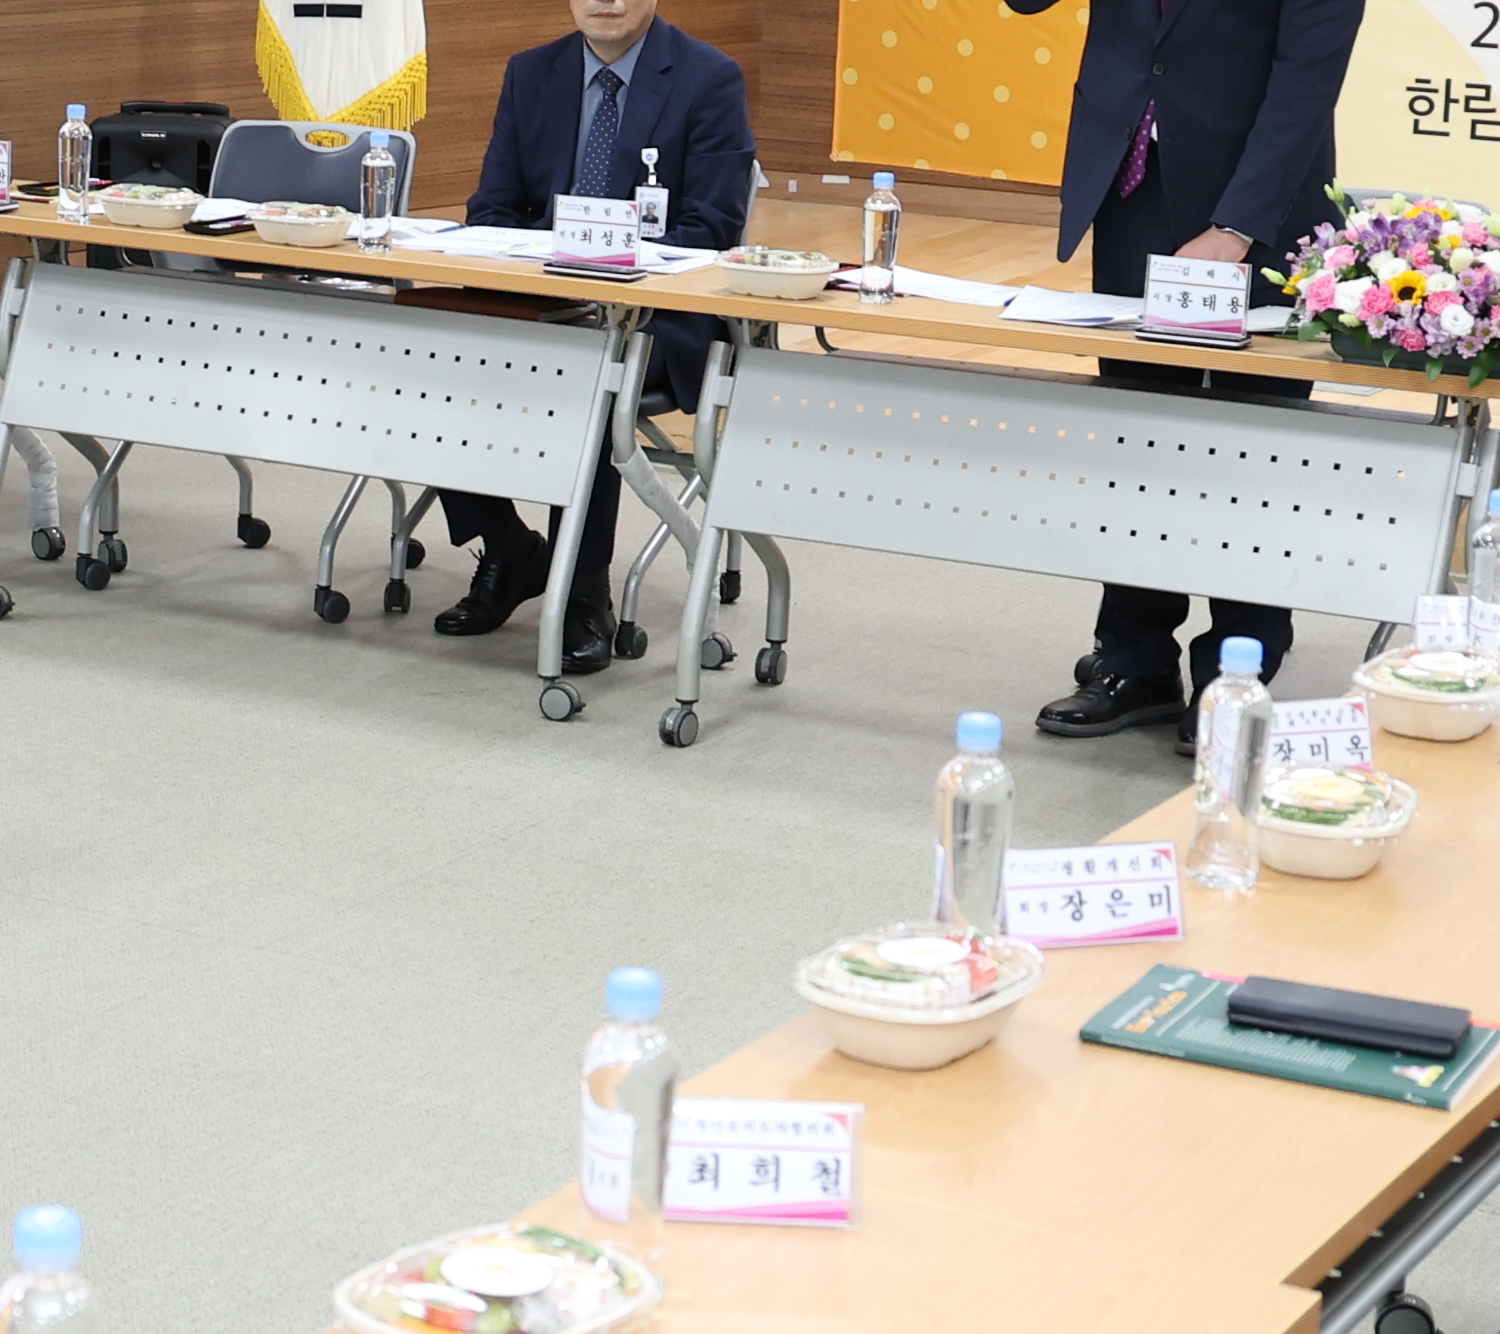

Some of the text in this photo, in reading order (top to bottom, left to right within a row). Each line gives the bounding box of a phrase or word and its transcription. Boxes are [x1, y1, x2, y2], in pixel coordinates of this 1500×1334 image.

[580, 229, 636, 248] 최성훈
[1177, 291, 1243, 313] 홍태용
[1060, 884, 1172, 923] 장은미
[688, 1152, 843, 1198] 최희철
